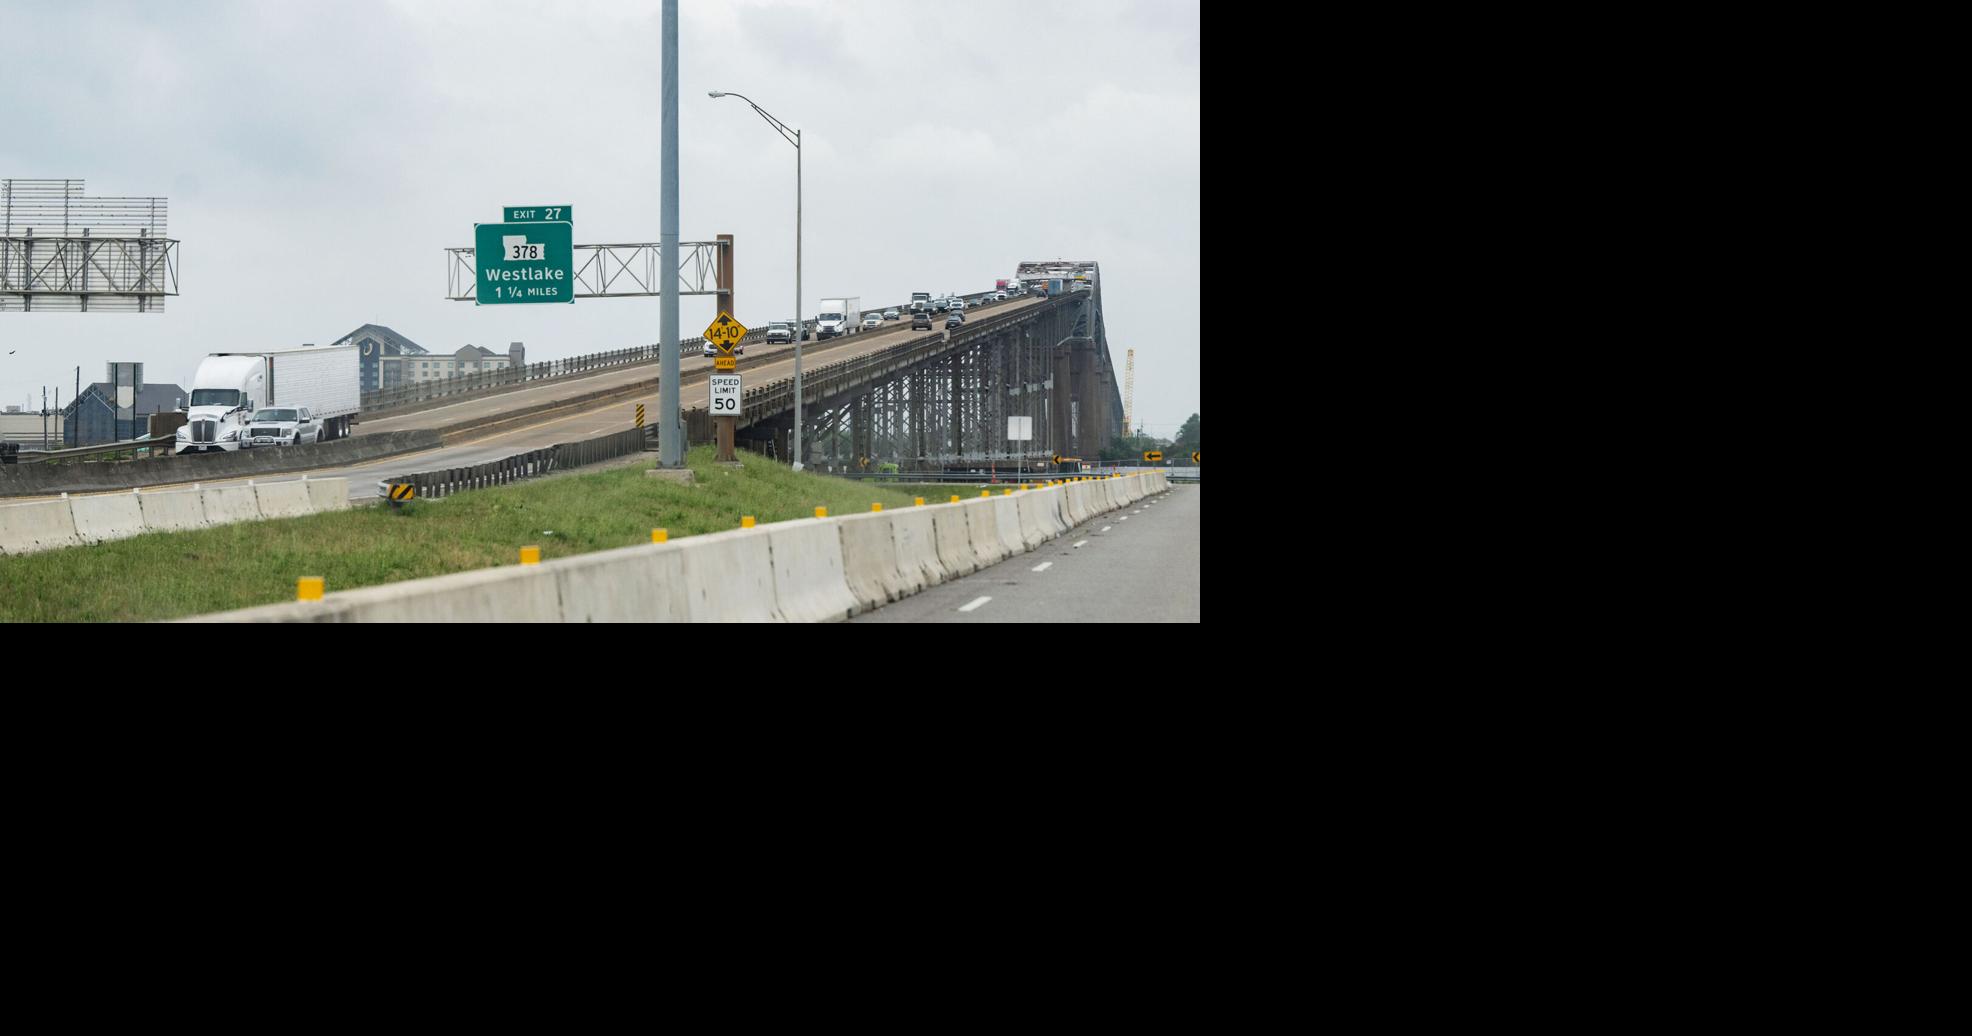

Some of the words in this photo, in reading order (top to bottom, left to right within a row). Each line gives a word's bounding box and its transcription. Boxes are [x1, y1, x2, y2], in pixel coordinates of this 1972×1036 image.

[513, 210, 536, 219] EXIT
[545, 208, 561, 220] 27
[513, 245, 538, 259] 378
[486, 267, 564, 281] Westlake
[495, 286, 502, 299] 1
[527, 287, 558, 296] MILES
[712, 378, 740, 386] SPEED
[714, 398, 736, 410] 50
